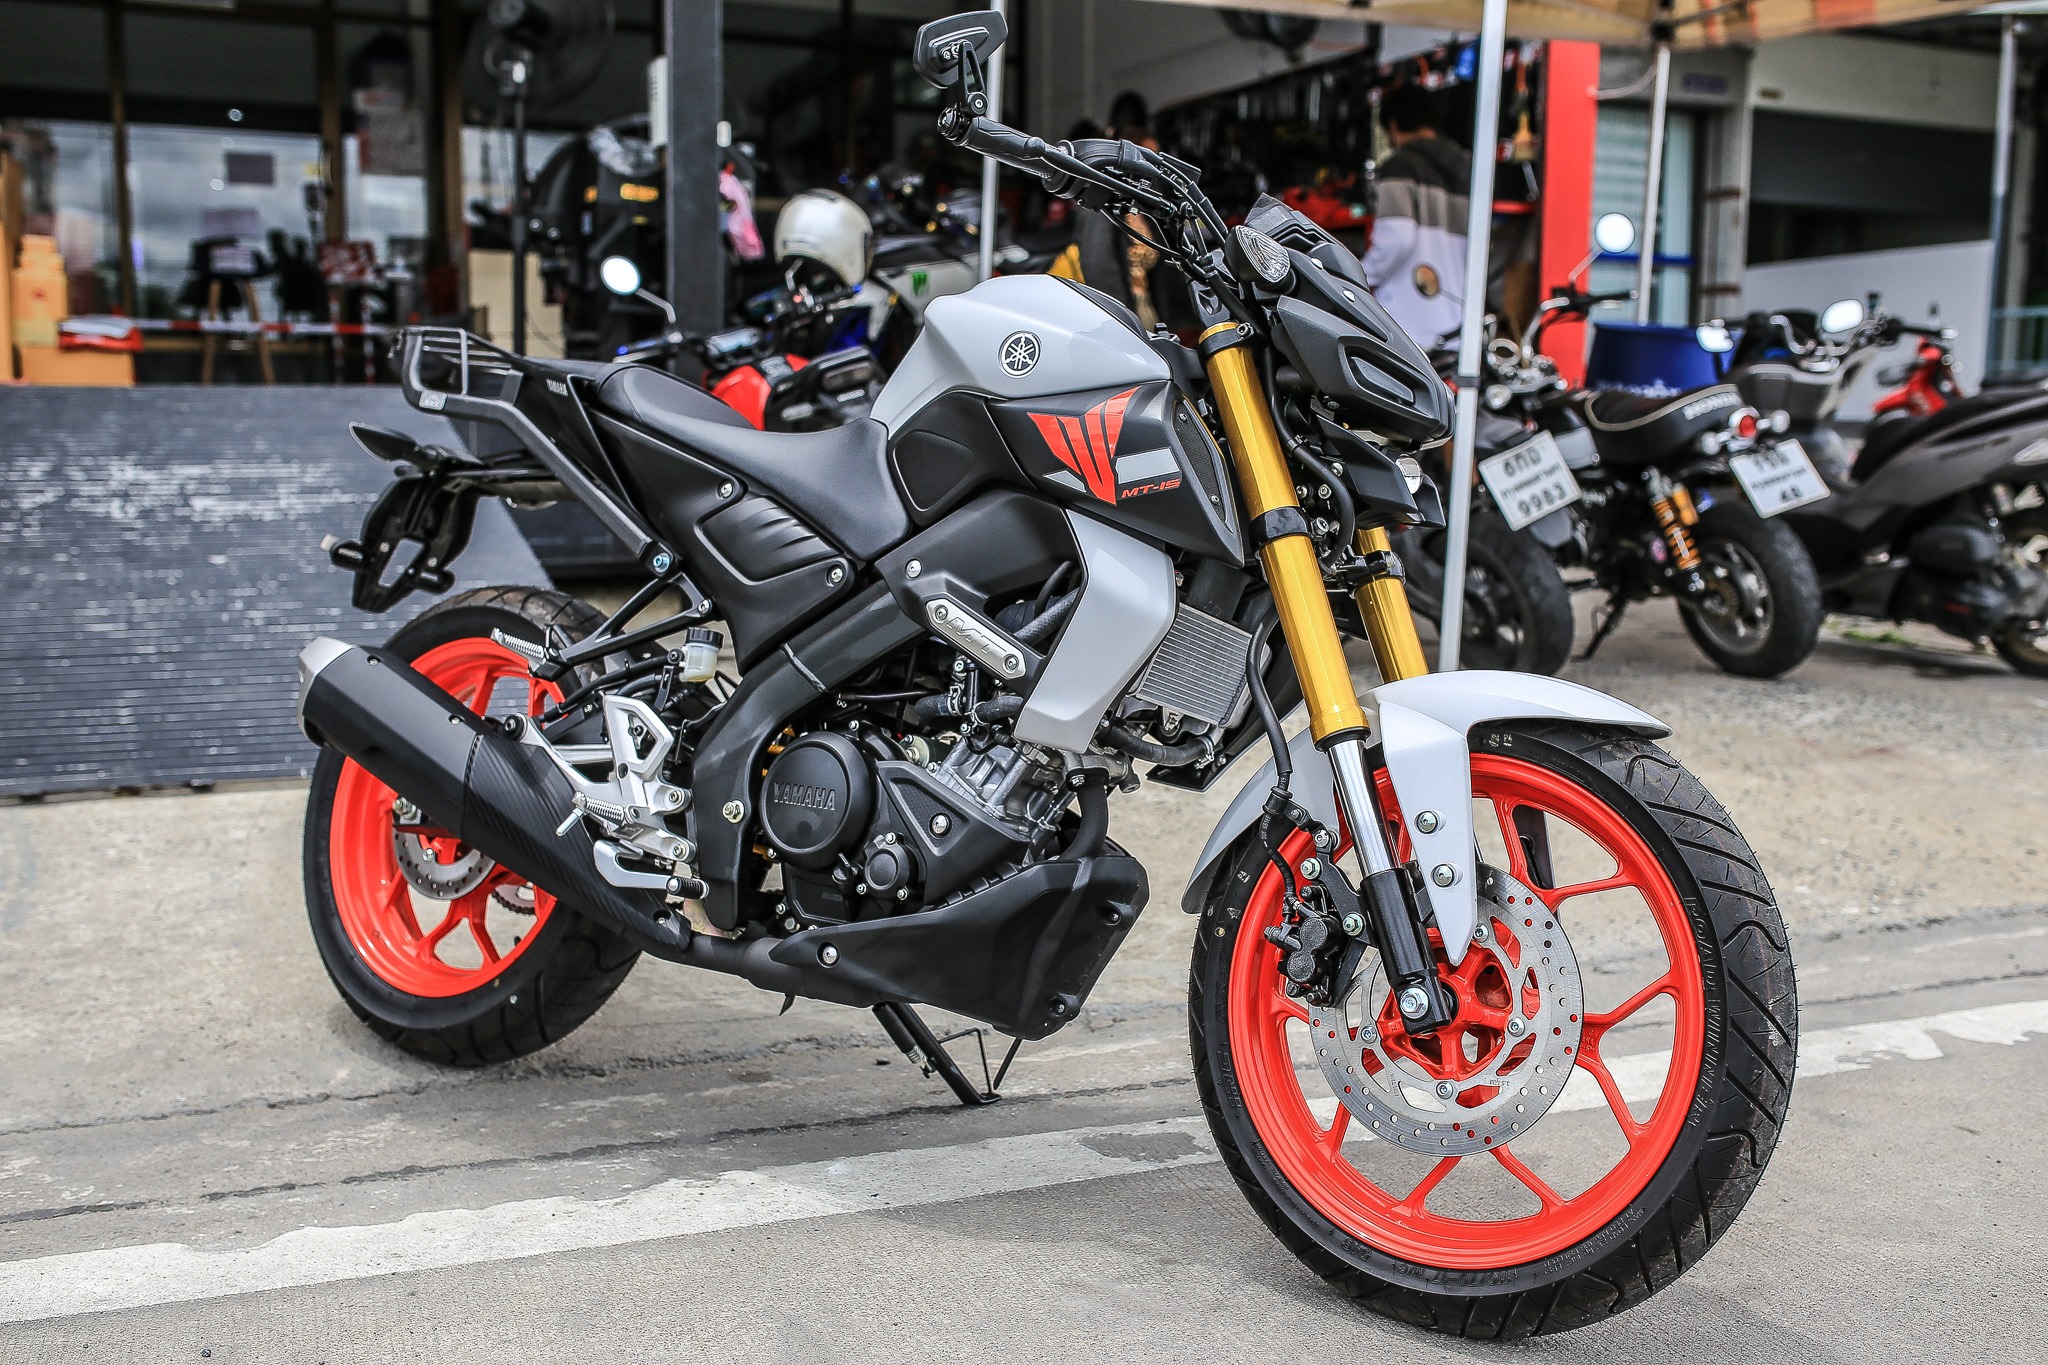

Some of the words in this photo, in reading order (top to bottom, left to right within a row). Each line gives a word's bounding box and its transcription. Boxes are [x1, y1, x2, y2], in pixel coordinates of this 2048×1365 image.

[1120, 478, 1182, 499] MT-15
[946, 616, 1008, 655] MT
[773, 781, 836, 811] YAMAHA
